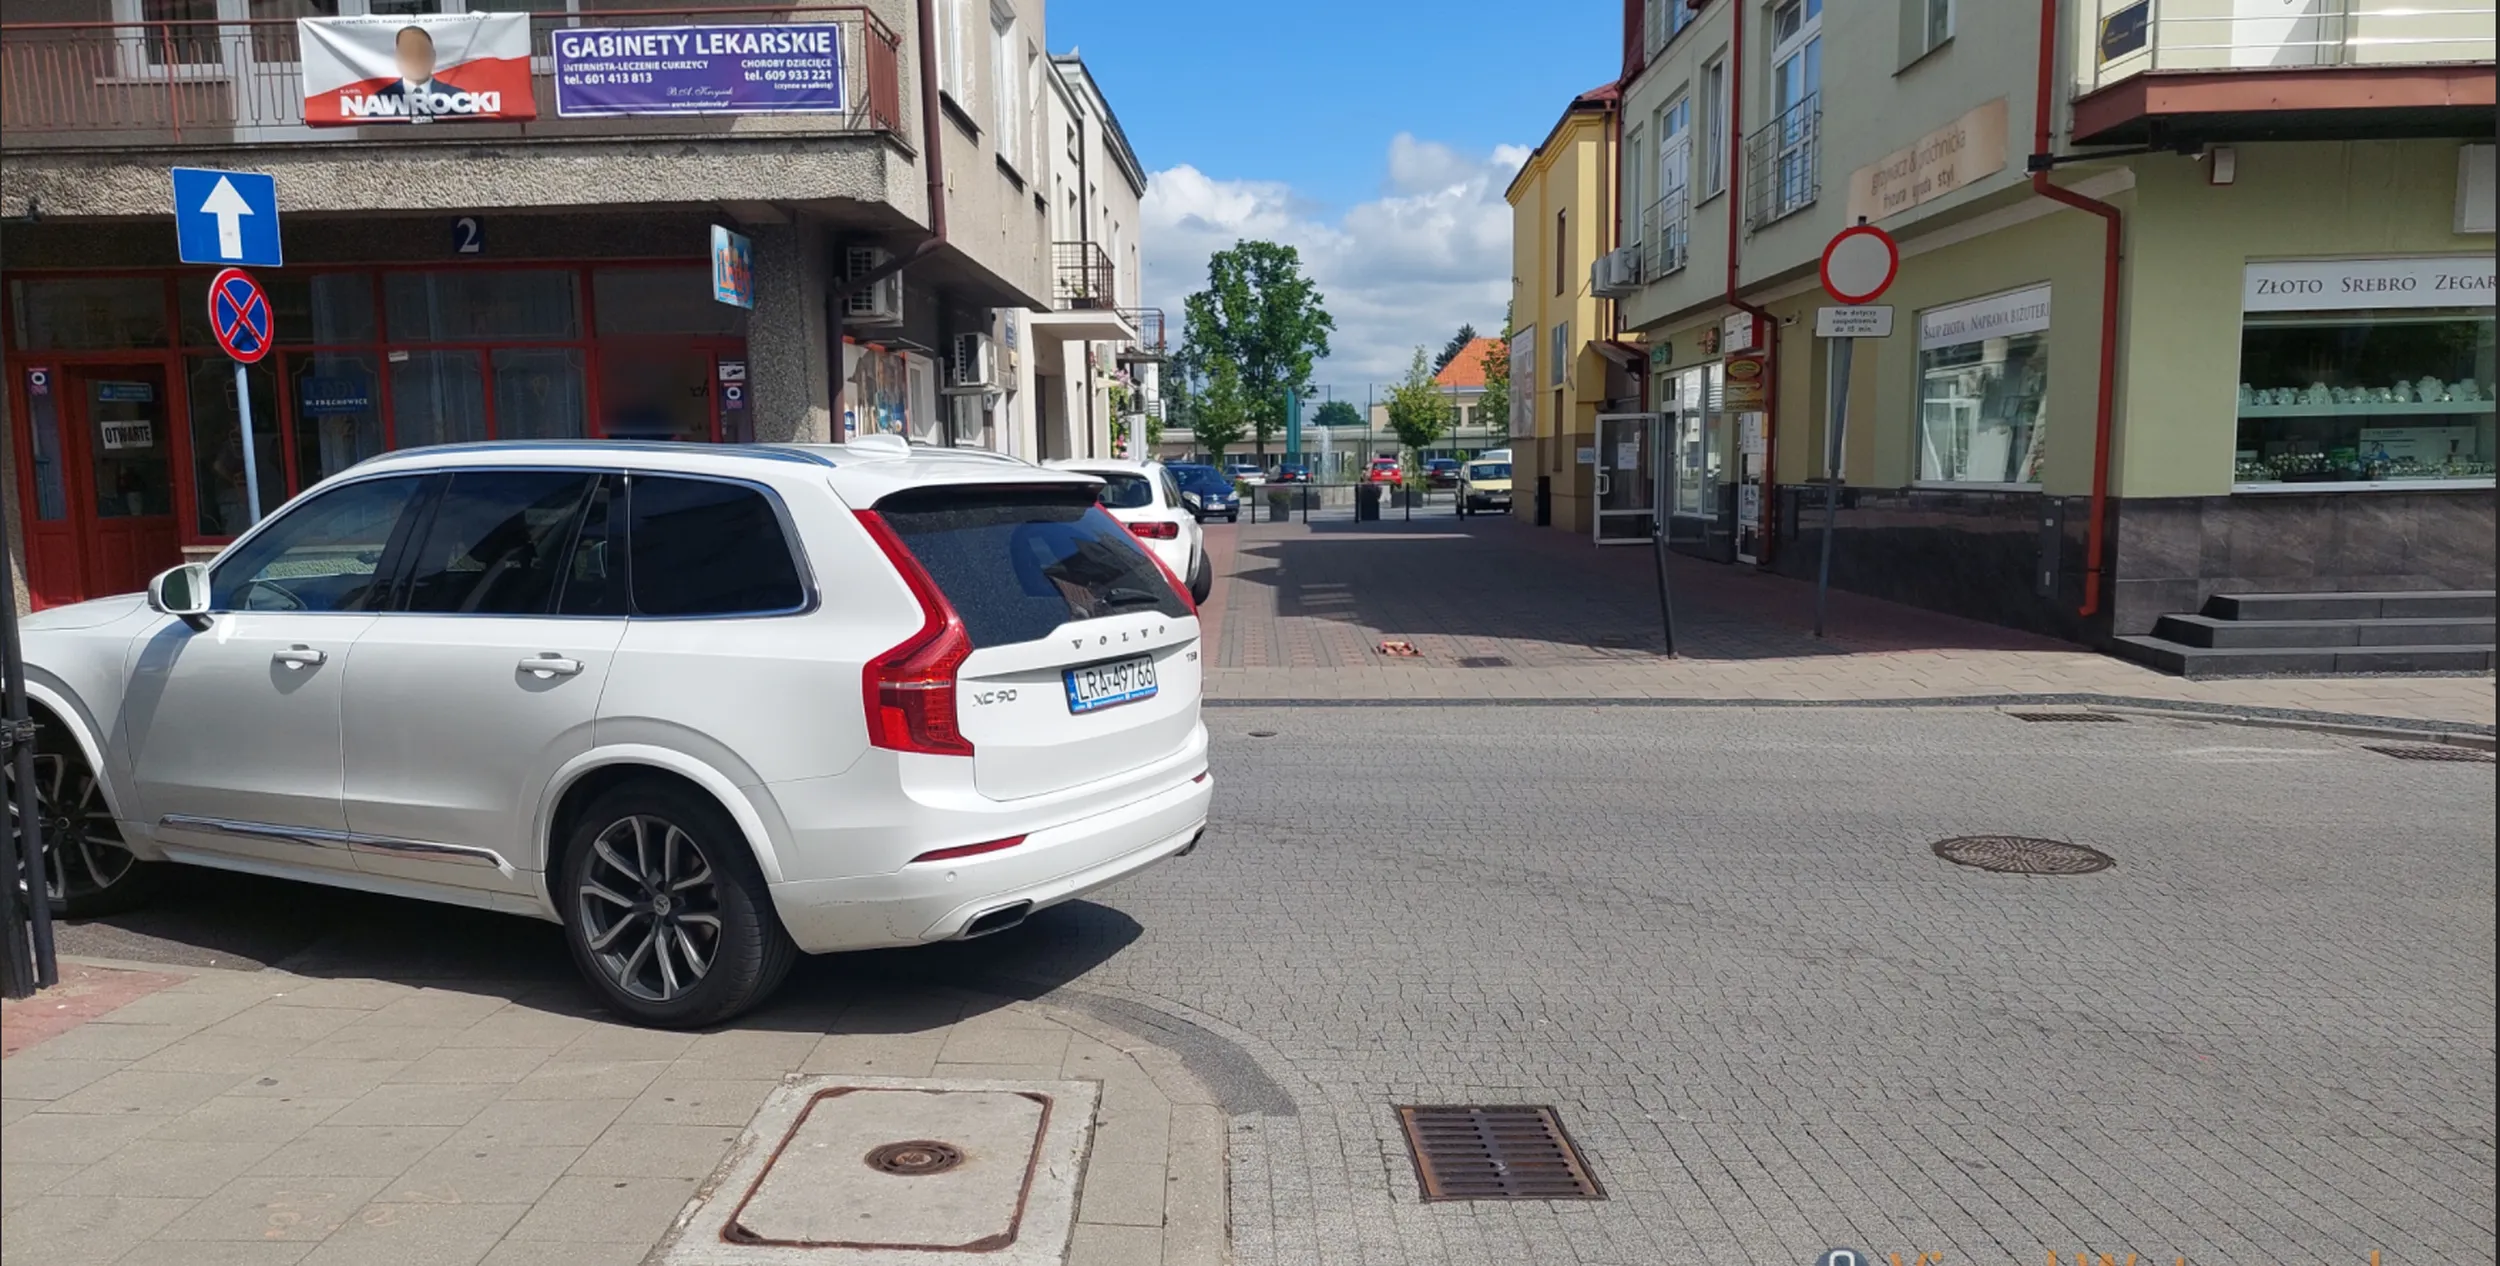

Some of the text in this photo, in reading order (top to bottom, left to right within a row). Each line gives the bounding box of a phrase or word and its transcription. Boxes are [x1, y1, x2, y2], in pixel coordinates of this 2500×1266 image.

[562, 31, 832, 58] GABINETY LEKARSKIE
[563, 60, 709, 72] INTERNISTA-LECZENIE CUKRZYCY
[741, 59, 785, 68] CHOROBY
[564, 72, 653, 85] tel. 601 413 813
[744, 69, 832, 81] tel. 609 933 221
[340, 91, 500, 116] NAWROCKI
[457, 217, 480, 252] 2
[2256, 278, 2323, 294] ZŁOTO
[1923, 324, 1942, 340] SKUP
[1970, 309, 2010, 332] NAPRAWA
[104, 425, 150, 444] OTWARTE
[1072, 625, 1165, 650] VOLVO
[1075, 660, 1153, 701] LRA 49766
